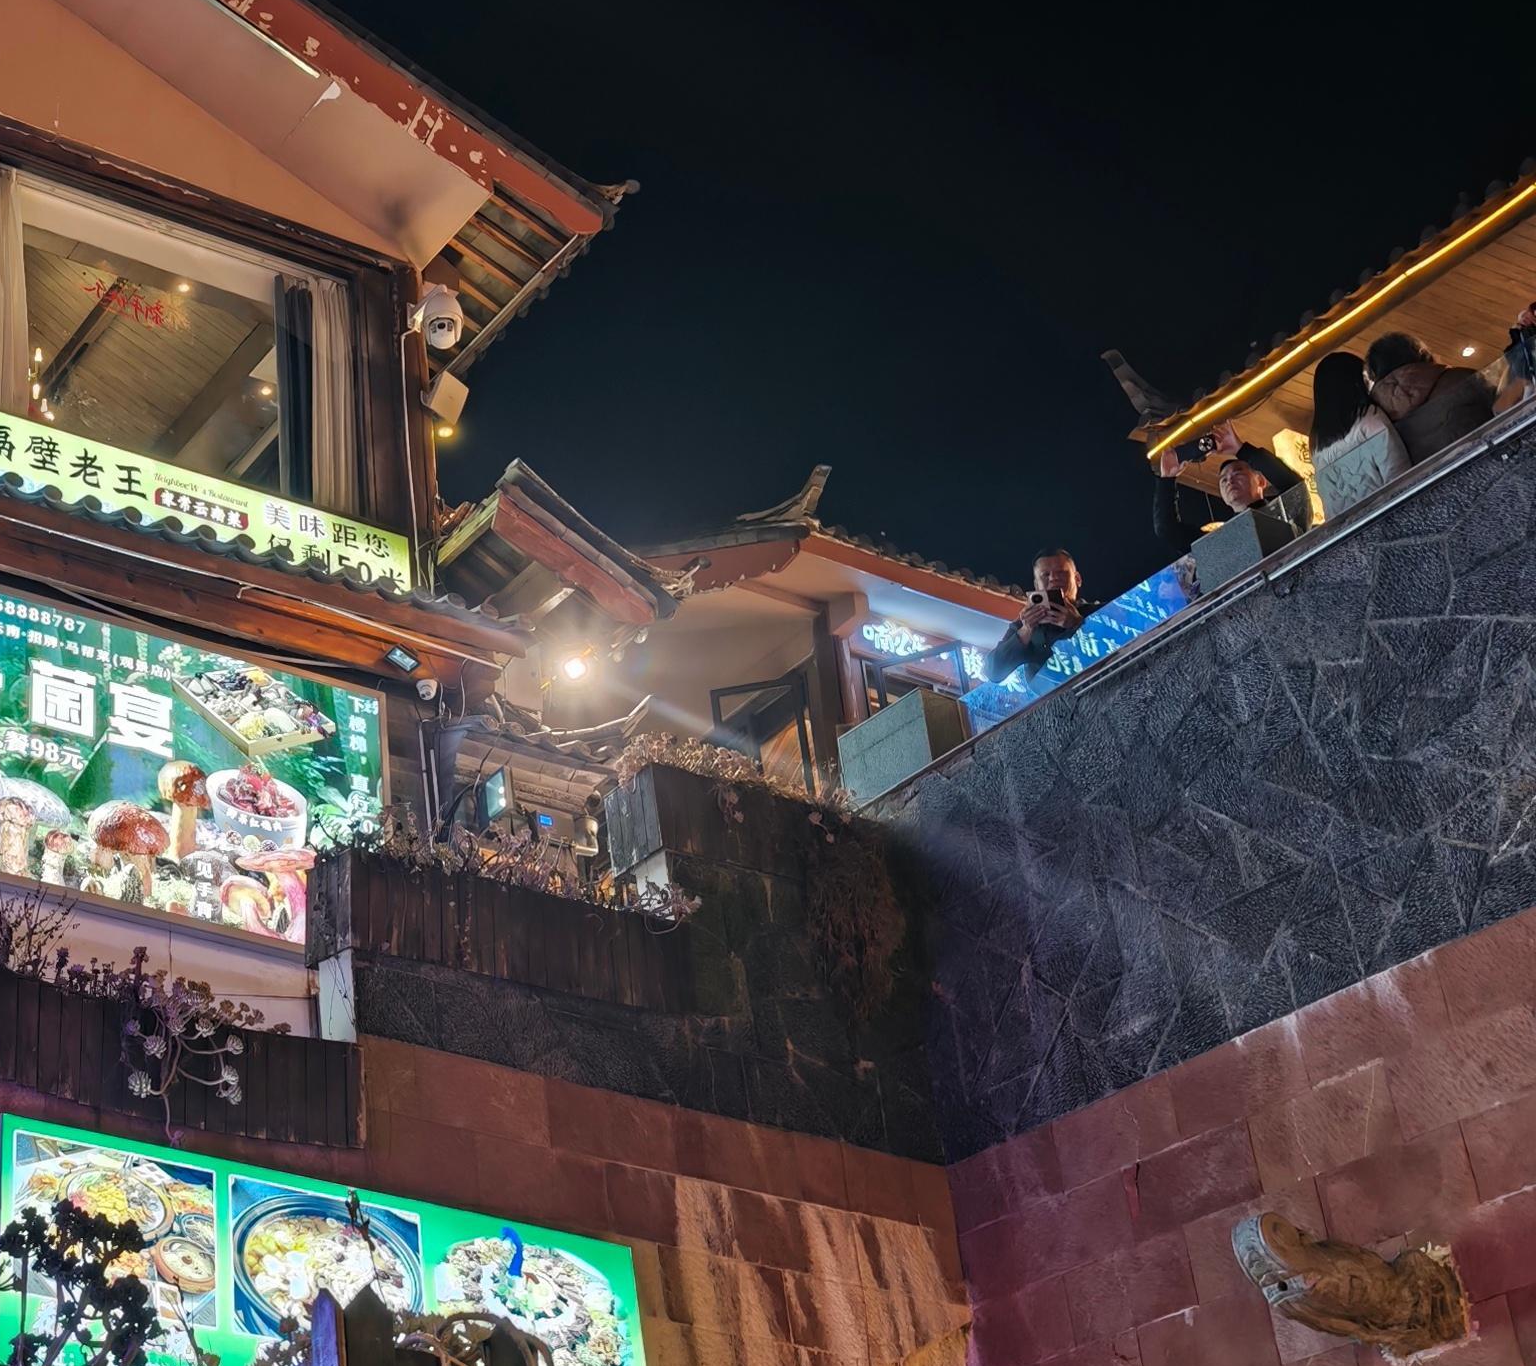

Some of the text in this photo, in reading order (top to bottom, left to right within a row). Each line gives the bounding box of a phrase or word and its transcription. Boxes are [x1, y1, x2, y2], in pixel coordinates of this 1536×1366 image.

[160, 490, 244, 528] 家常云南菜
[264, 501, 391, 559] 美味距您
[196, 860, 214, 920] 见手青
